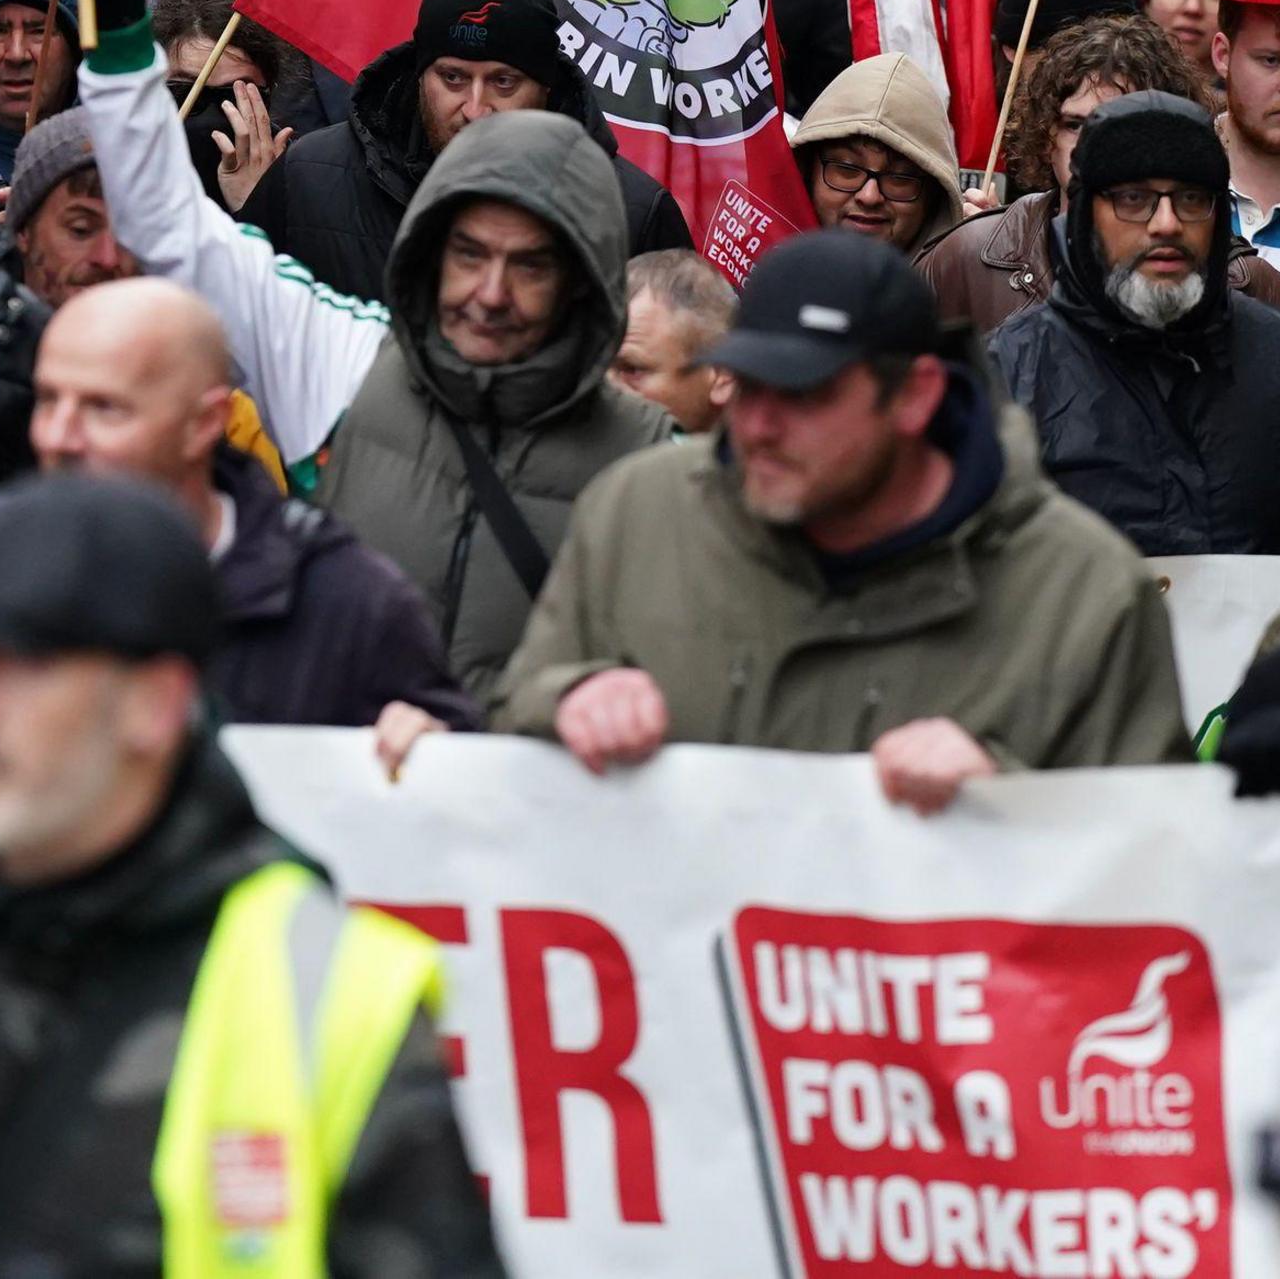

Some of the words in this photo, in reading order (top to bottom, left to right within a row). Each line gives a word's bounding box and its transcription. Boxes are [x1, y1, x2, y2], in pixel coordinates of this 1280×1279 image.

[448, 23, 488, 41] unite
[554, 20, 638, 98] BIN
[649, 41, 773, 119] WORKE
[718, 208, 747, 243] FOR
[746, 236, 761, 255] A
[724, 189, 774, 234] UNITE
[751, 939, 996, 1046] UNITE
[780, 1056, 947, 1155] FOR
[953, 1069, 1017, 1162] A
[1038, 1066, 1195, 1130] unite
